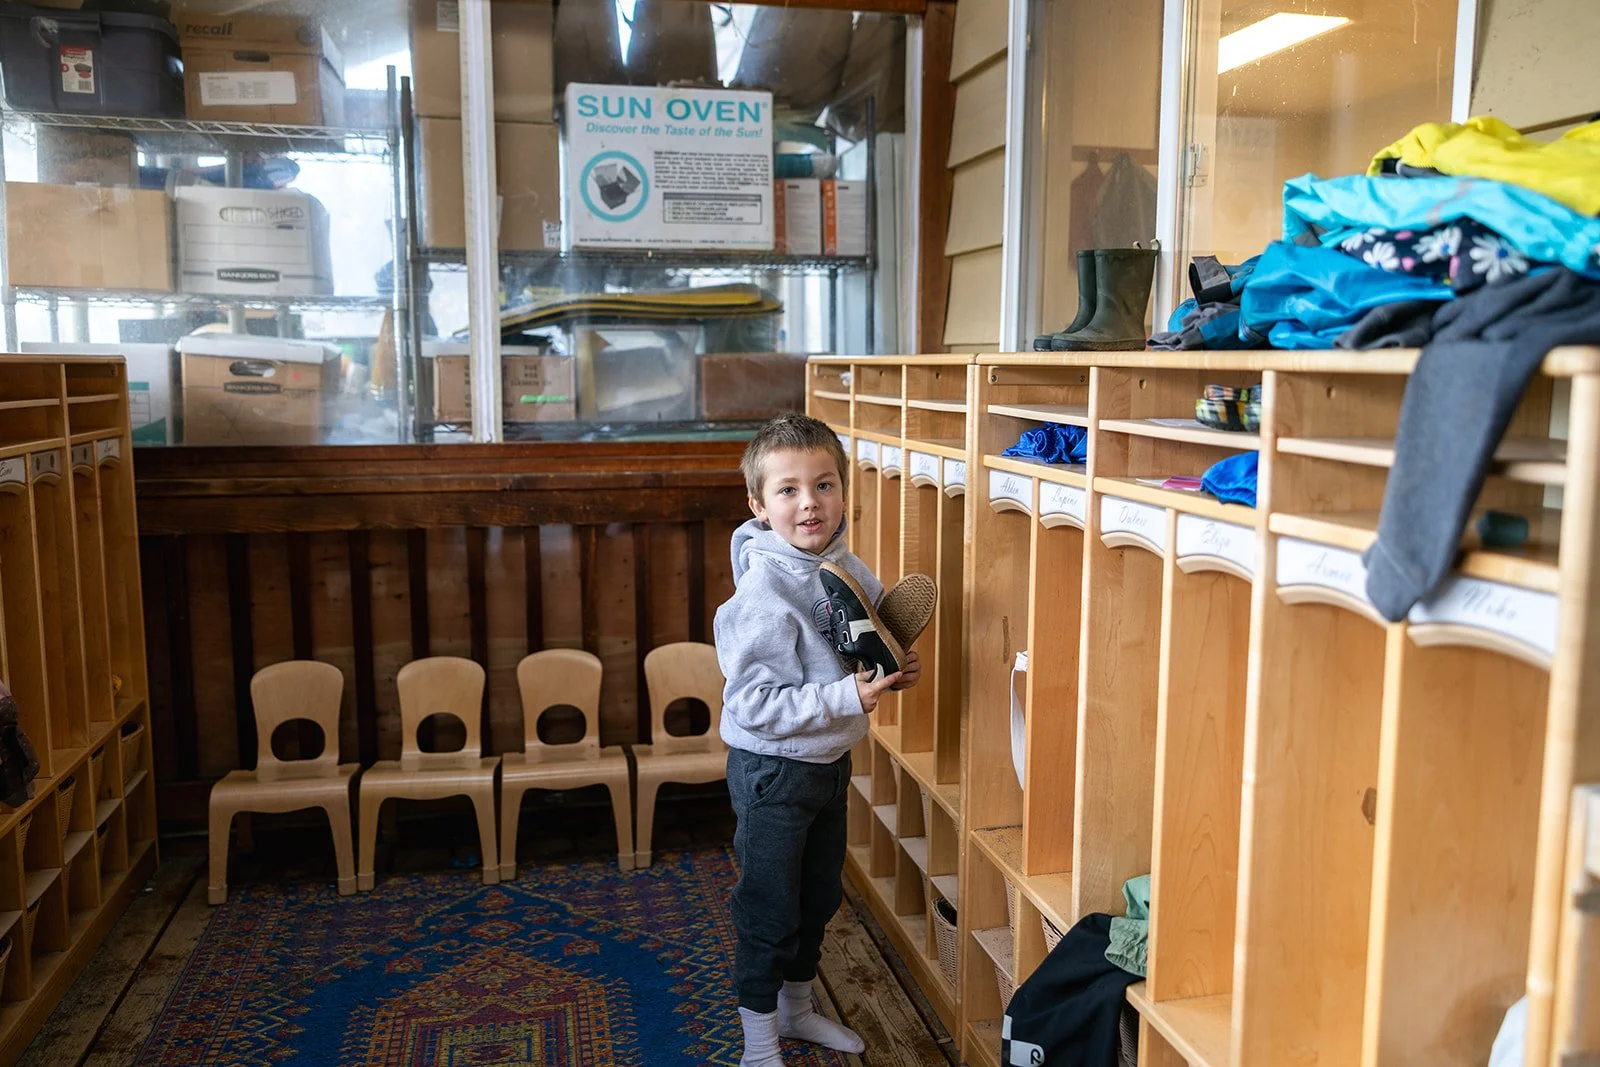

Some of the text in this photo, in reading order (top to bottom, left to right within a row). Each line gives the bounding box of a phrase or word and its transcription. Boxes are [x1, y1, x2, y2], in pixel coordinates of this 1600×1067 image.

[186, 22, 233, 36] recall
[577, 94, 652, 120] SUN
[586, 122, 763, 138] Discover the Taste of the Sun!
[220, 271, 258, 280] BANKERS
